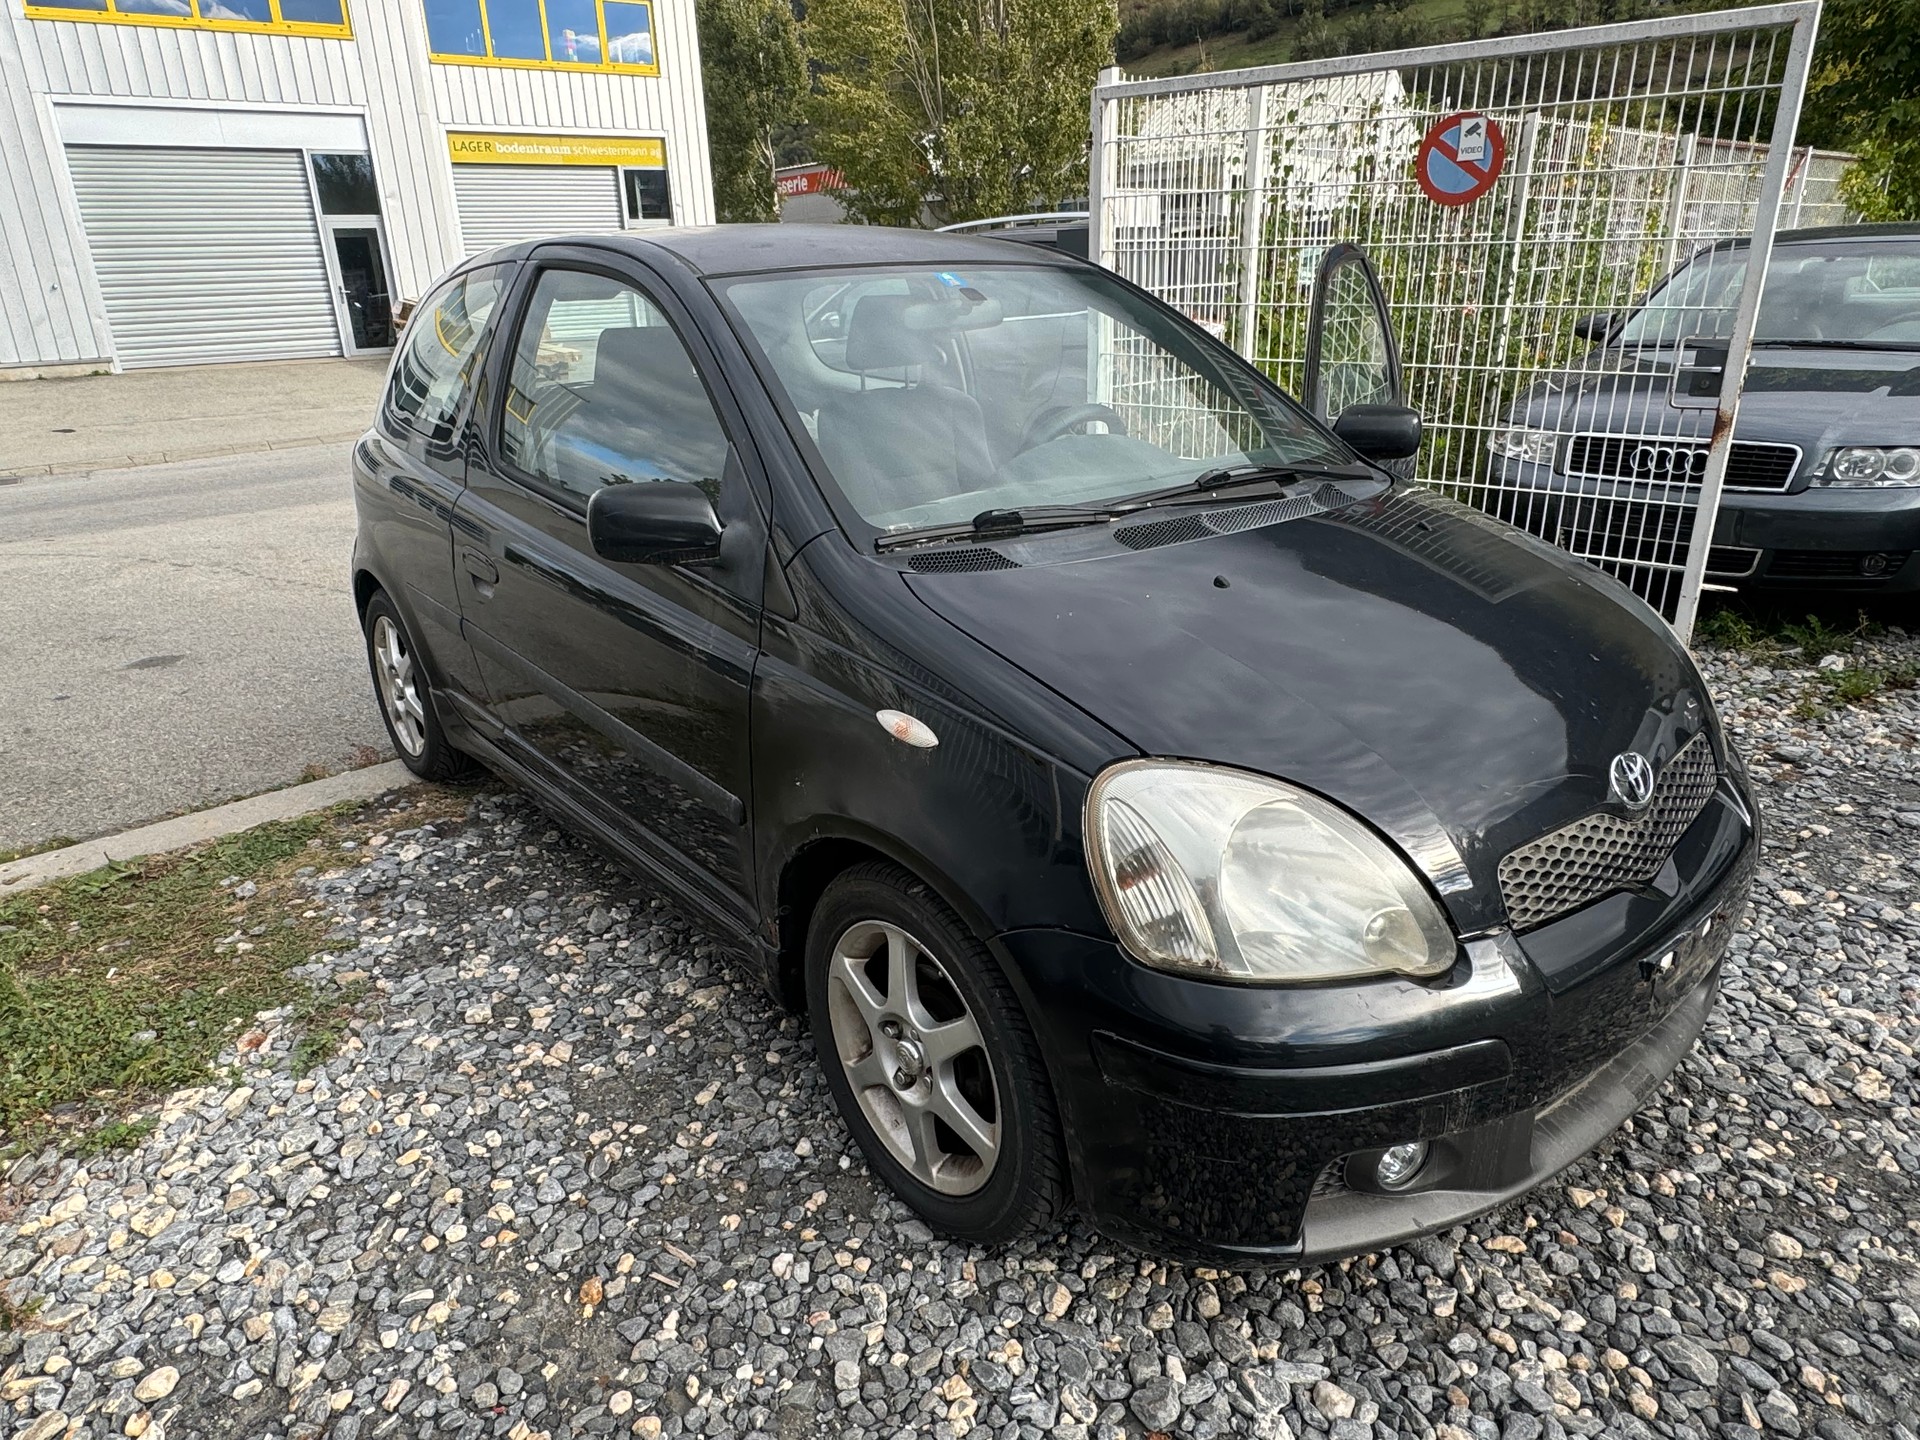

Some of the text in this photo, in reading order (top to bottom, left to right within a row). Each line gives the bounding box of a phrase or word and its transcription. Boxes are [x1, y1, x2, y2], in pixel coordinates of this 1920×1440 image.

[452, 140, 492, 153] LAGER
[496, 141, 571, 155] bodentraum
[572, 145, 647, 156] schwestermann
